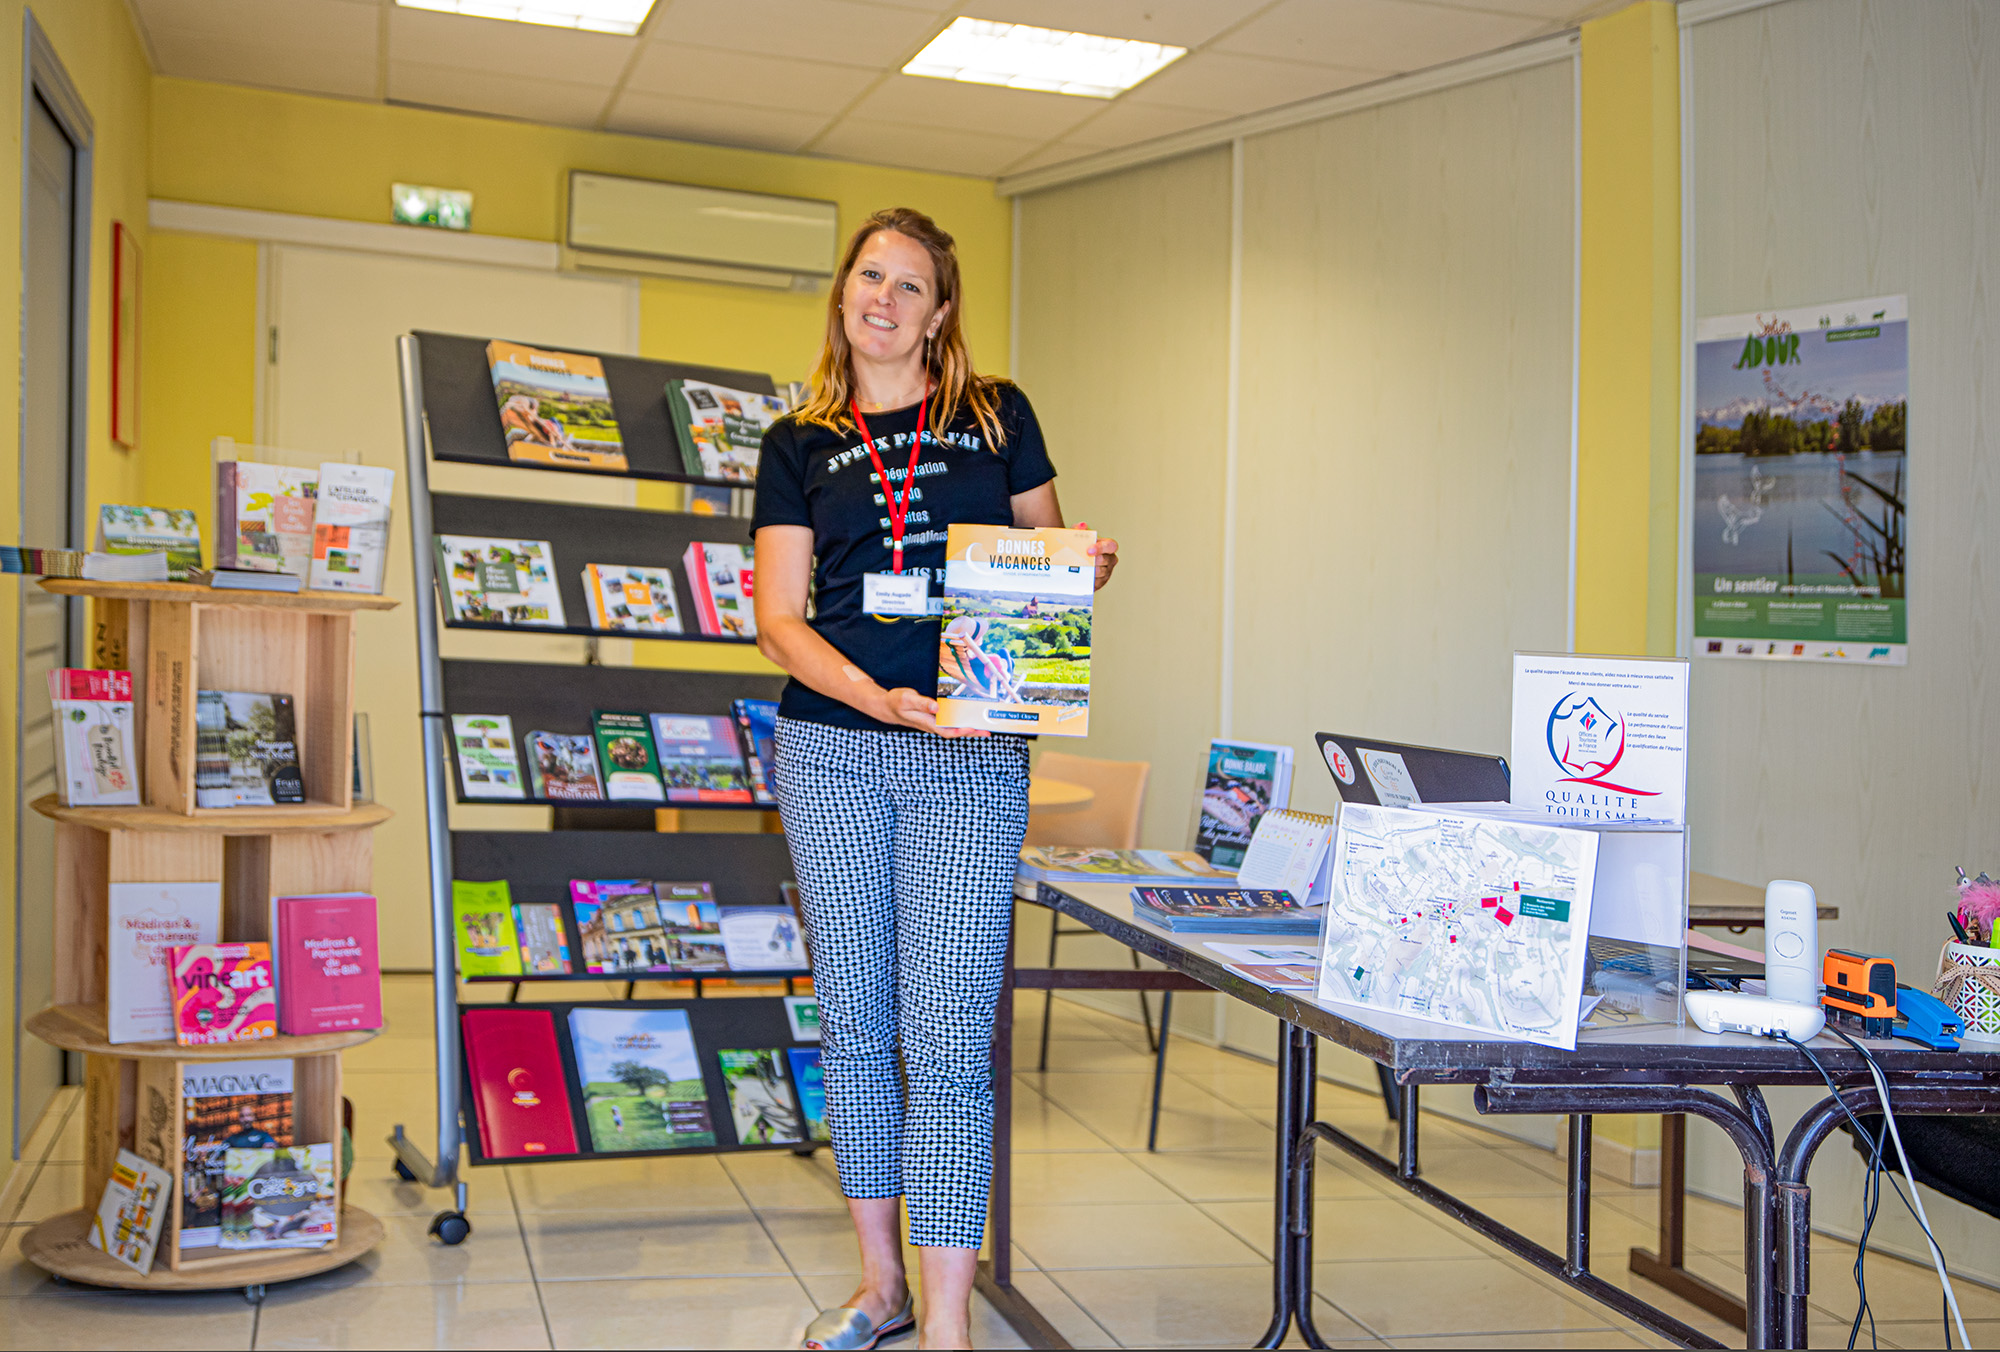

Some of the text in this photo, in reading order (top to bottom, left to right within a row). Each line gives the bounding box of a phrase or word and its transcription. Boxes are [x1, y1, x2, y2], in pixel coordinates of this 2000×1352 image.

[1738, 333, 1801, 370] ADOUR
[883, 461, 947, 482] Dégutation
[902, 530, 947, 546] nimations
[996, 538, 1045, 556] BONNES
[990, 555, 1050, 571] VACANCES
[1714, 577, 1733, 593] Un
[1735, 576, 1778, 594] sentier
[1224, 758, 1267, 775] BONNE BALADE
[1546, 790, 1637, 808] QUALITE
[126, 918, 179, 929] Madiran
[304, 936, 355, 949] Madiran &
[312, 947, 362, 959] Pacherenc
[326, 958, 340, 967] du
[184, 1074, 270, 1094] RMAGNAC
